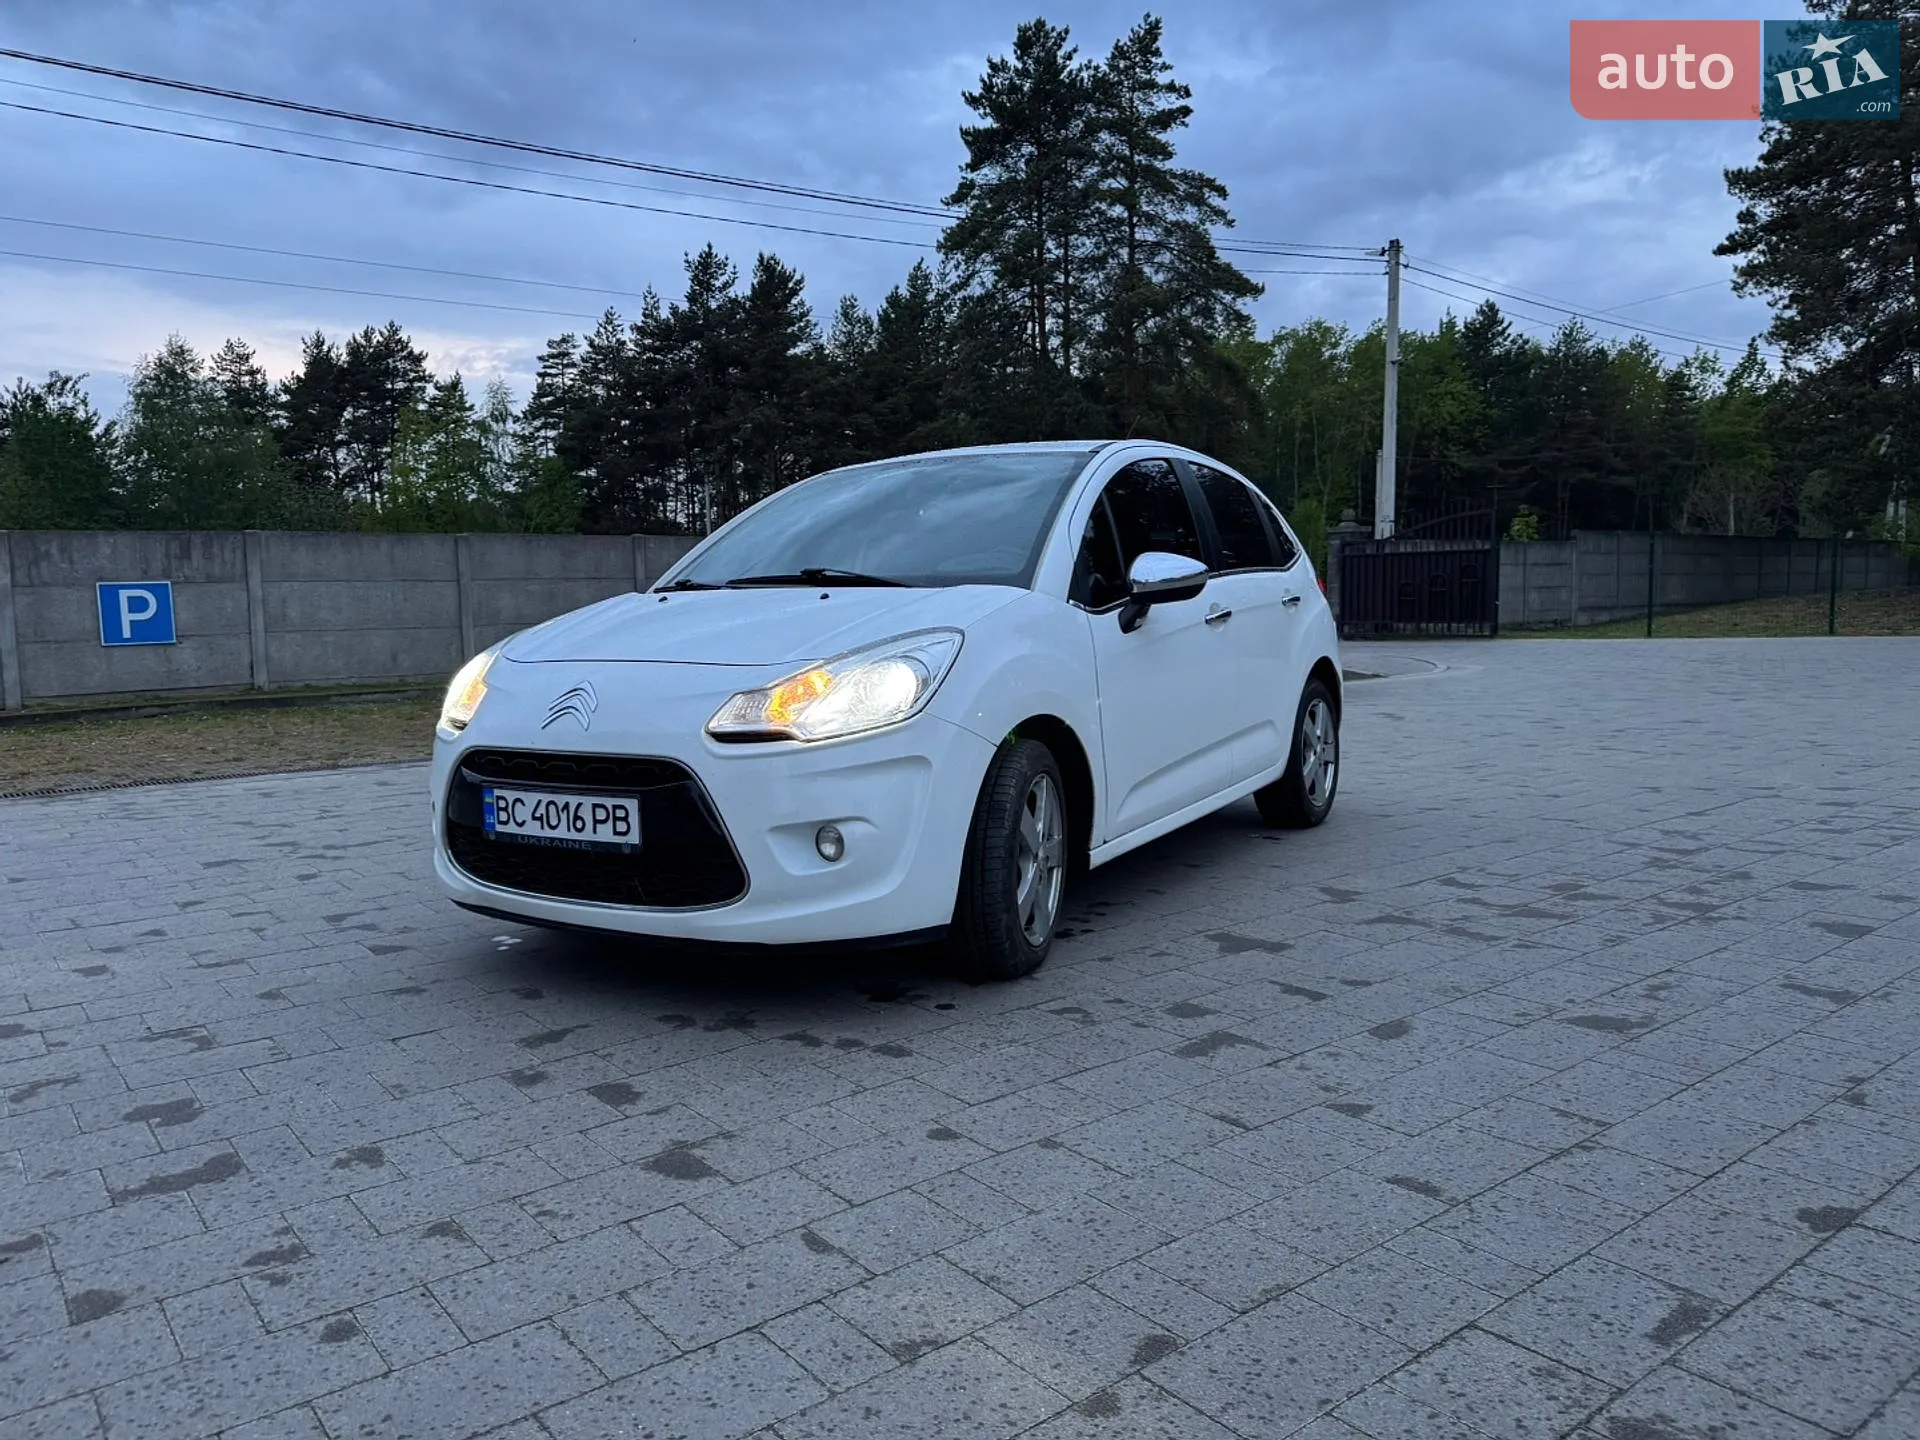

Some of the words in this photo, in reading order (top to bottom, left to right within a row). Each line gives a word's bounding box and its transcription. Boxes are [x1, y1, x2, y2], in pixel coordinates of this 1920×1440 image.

[118, 589, 157, 639] P
[496, 795, 526, 828] BC
[532, 799, 586, 833] 4016
[592, 803, 631, 836] PB
[517, 836, 592, 850] UKRAINE
